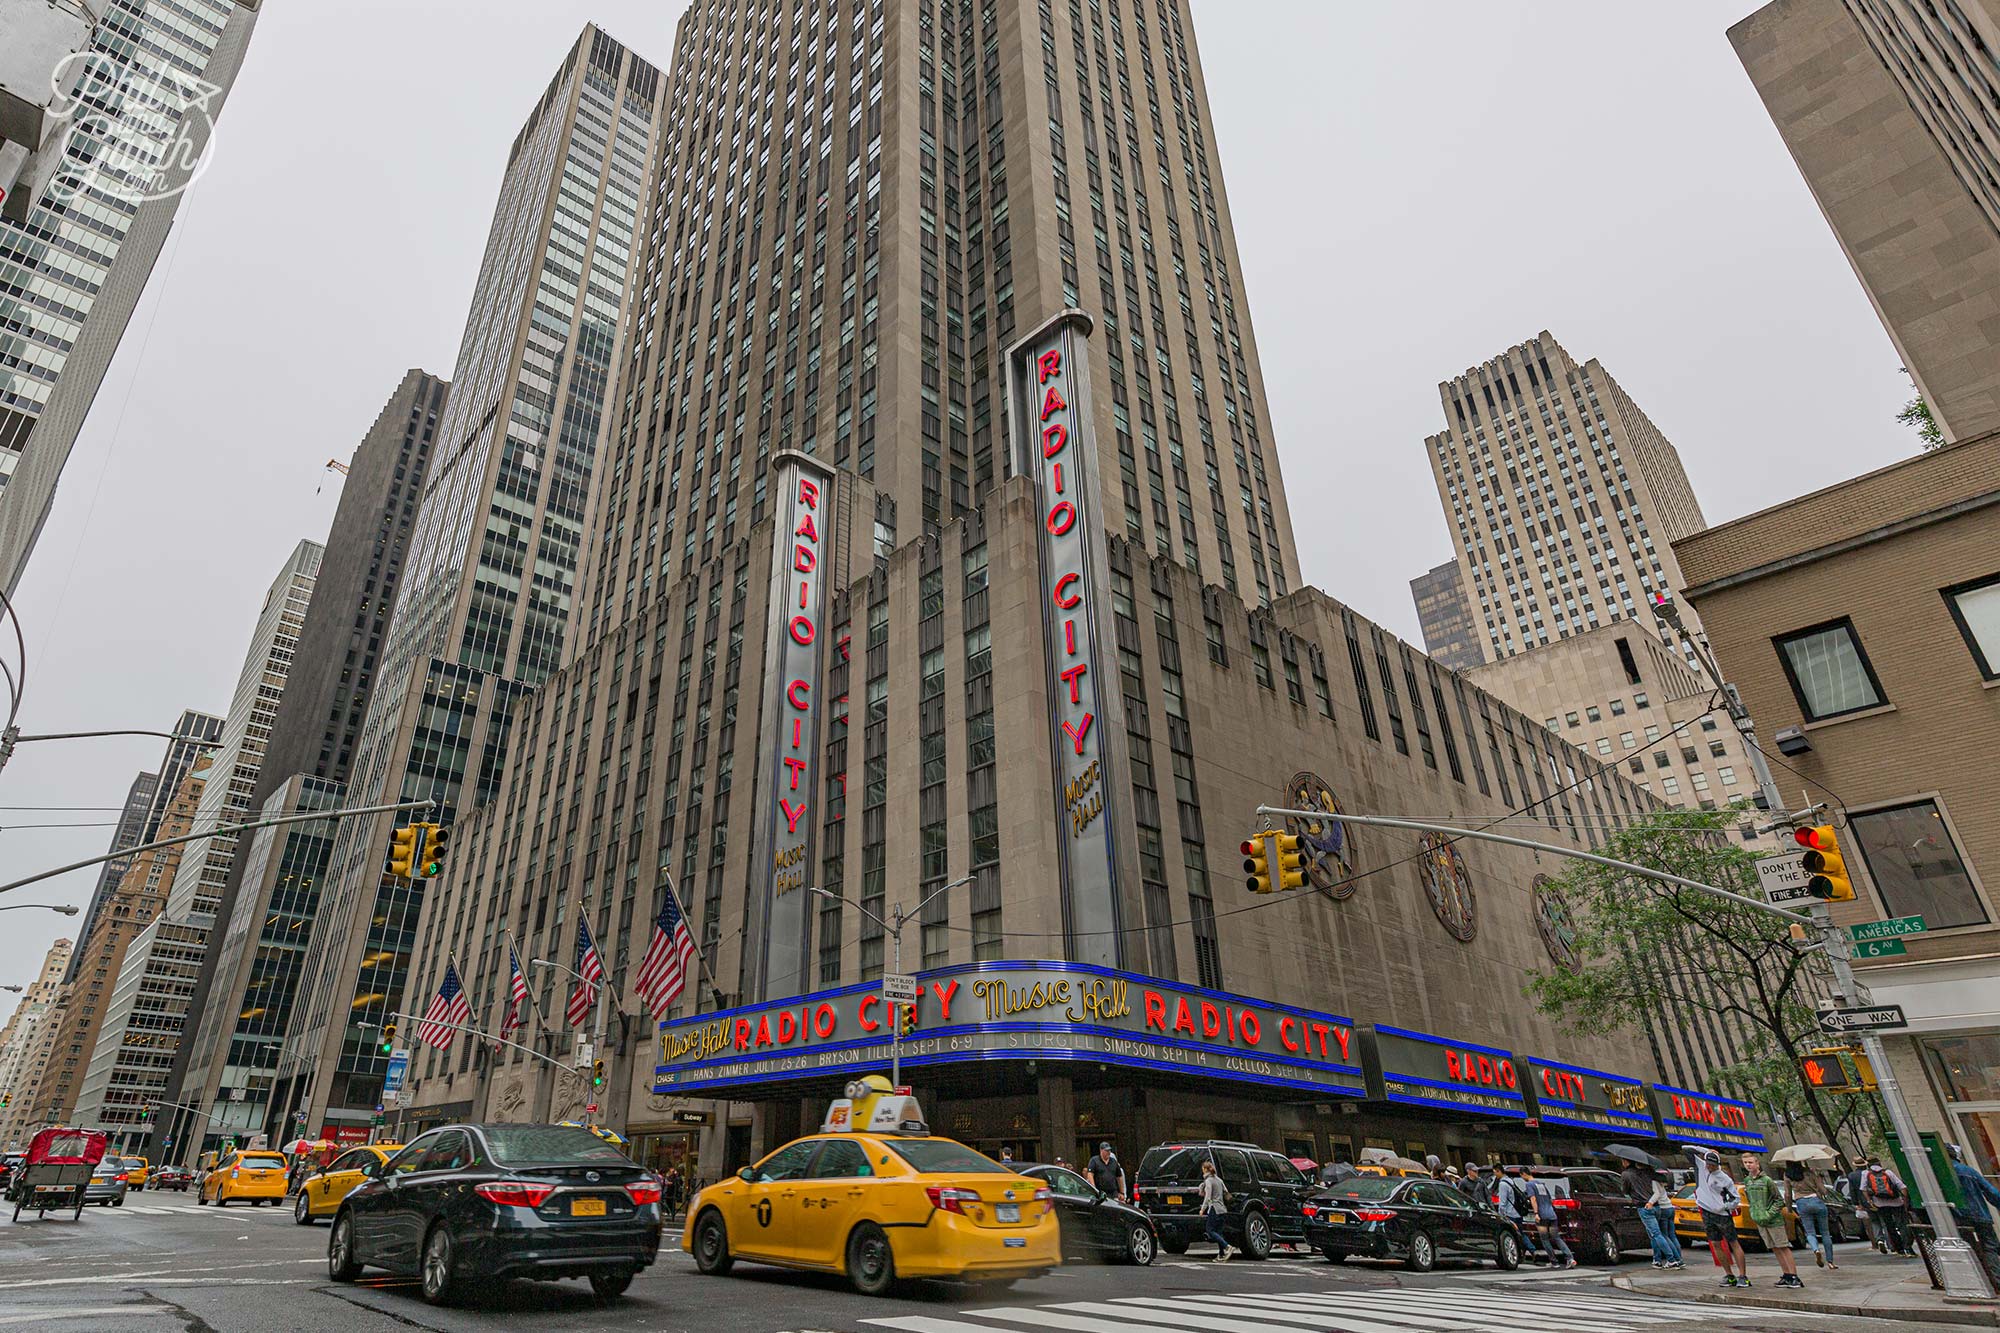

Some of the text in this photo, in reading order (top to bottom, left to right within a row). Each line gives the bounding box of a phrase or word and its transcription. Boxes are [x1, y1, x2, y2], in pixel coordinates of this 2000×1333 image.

[1038, 349, 1094, 755] RADIO CITY
[780, 479, 820, 833] RADIO CITY
[1762, 861, 1792, 874] DON'T
[1778, 872, 1800, 882] THE
[1772, 890, 1792, 900] FINE
[1858, 922, 1922, 939] AMERICAS
[1869, 944, 1880, 956] 6
[1883, 941, 1893, 949] AV
[972, 978, 1132, 1022] Music Hall
[735, 1002, 835, 1050] RADIO
[1144, 990, 1350, 1061] RADIO CITY
[1827, 1012, 1895, 1025] ONE WAY
[660, 1016, 733, 1064] Music Hall
[693, 1067, 714, 1080] HANS
[719, 1062, 749, 1078] ZIMMER
[754, 1058, 775, 1074] JULY
[781, 1055, 807, 1070] 25-26
[819, 1044, 859, 1065] BRYSON
[913, 1037, 941, 1054] SEPT
[951, 1036, 973, 1050] 8-9
[1009, 1033, 1094, 1049] STURGILL
[1104, 1037, 1156, 1058] SIMPSON
[1163, 1046, 1189, 1064] SEPT
[1197, 1051, 1206, 1065] 14
[1226, 1056, 1271, 1075] 2CELLOS
[1276, 1063, 1299, 1079] SEPT
[1304, 1068, 1313, 1081] 16
[1445, 1050, 1516, 1089] RADIO
[656, 1073, 675, 1084] CHASE
[1386, 1082, 1405, 1093] CHASE
[1543, 1068, 1586, 1101] CITY
[1672, 1095, 1747, 1129] RADIO CITY
